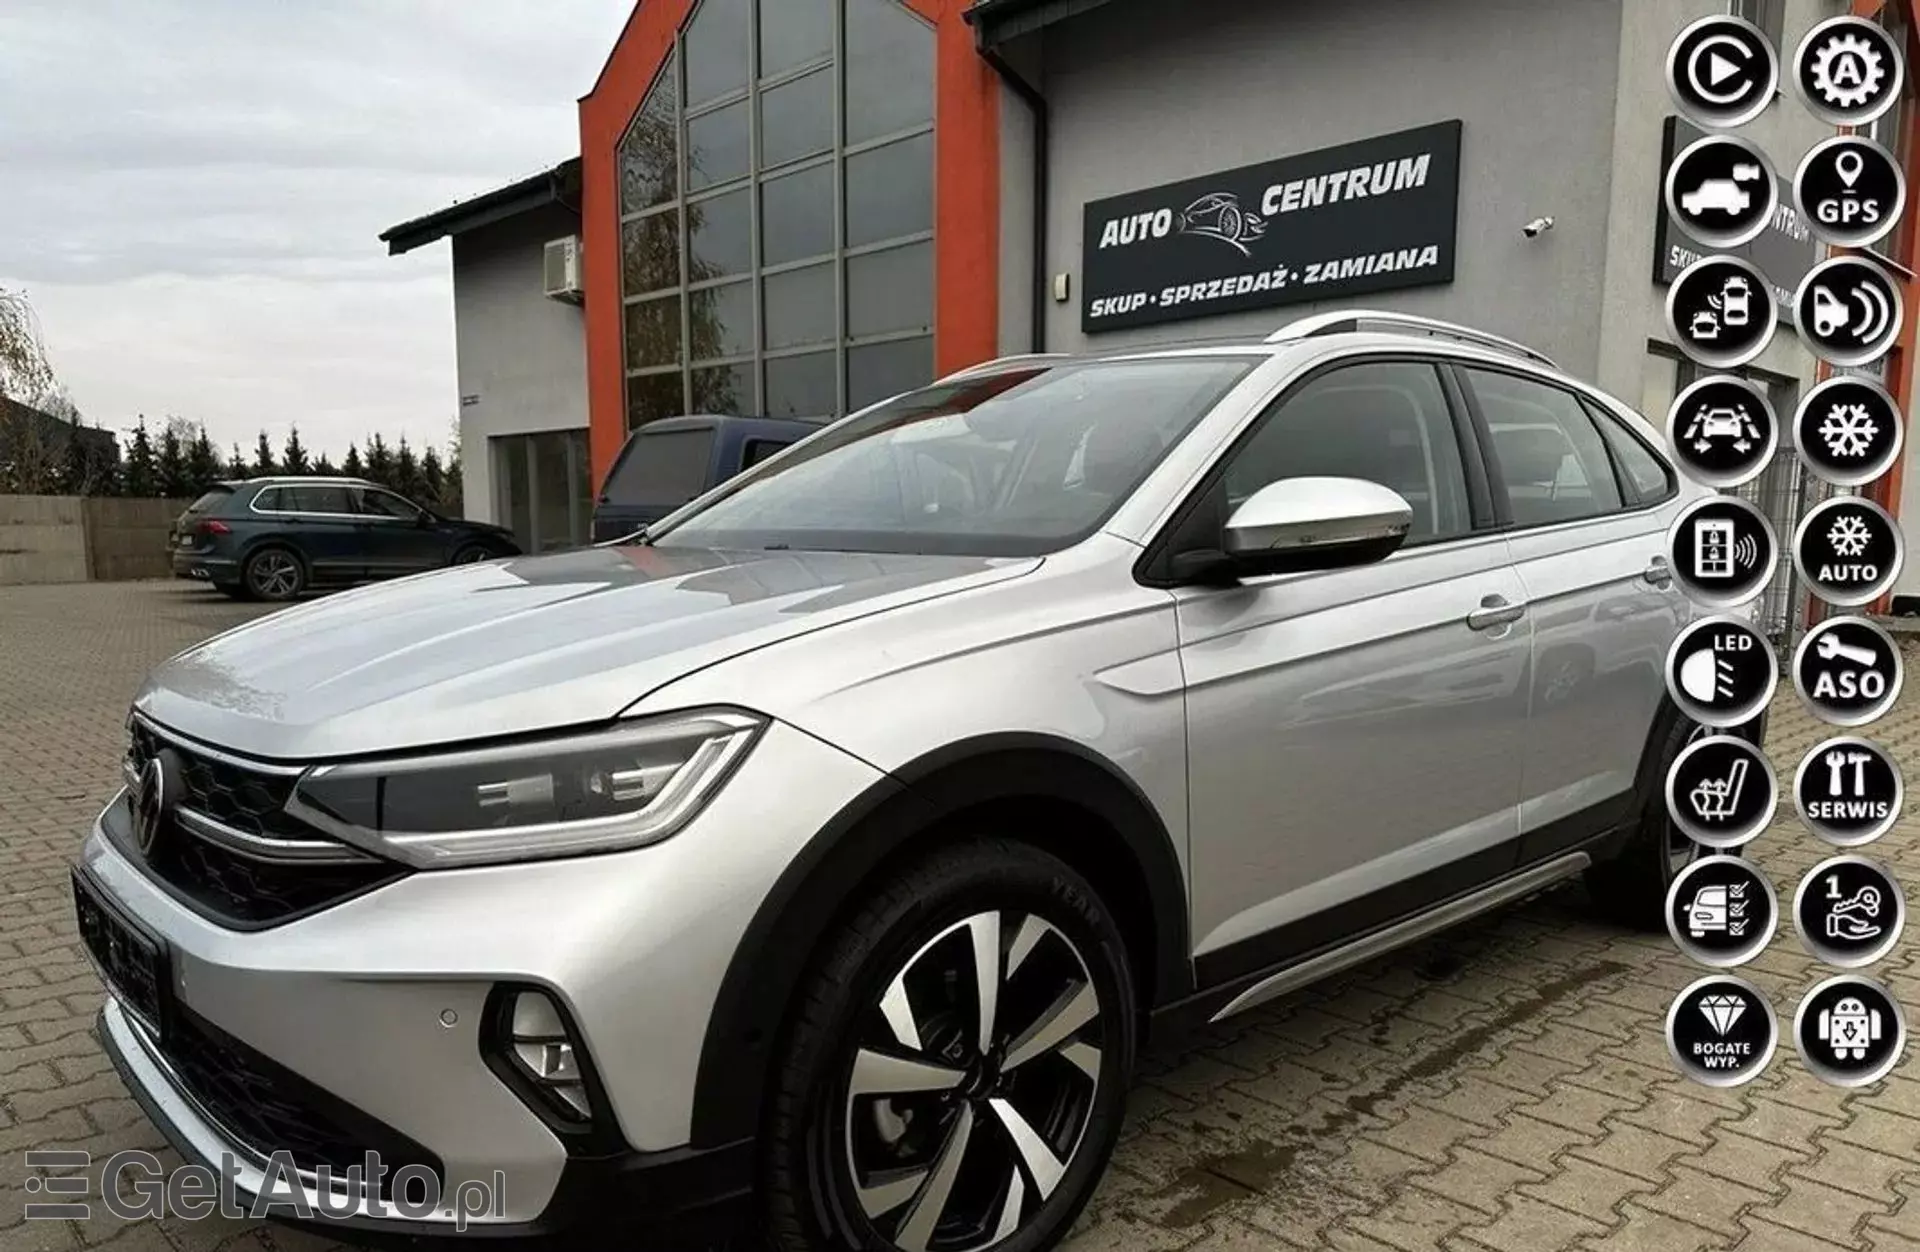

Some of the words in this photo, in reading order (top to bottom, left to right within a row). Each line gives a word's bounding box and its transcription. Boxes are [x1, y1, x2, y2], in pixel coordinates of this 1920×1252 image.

[1099, 208, 1172, 249] AUTO
[1260, 154, 1431, 217] CENTRUM
[1090, 290, 1146, 318] SKUP
[1159, 264, 1288, 308] SPRZEDAŻ
[1303, 245, 1439, 285] ZAMIANA
